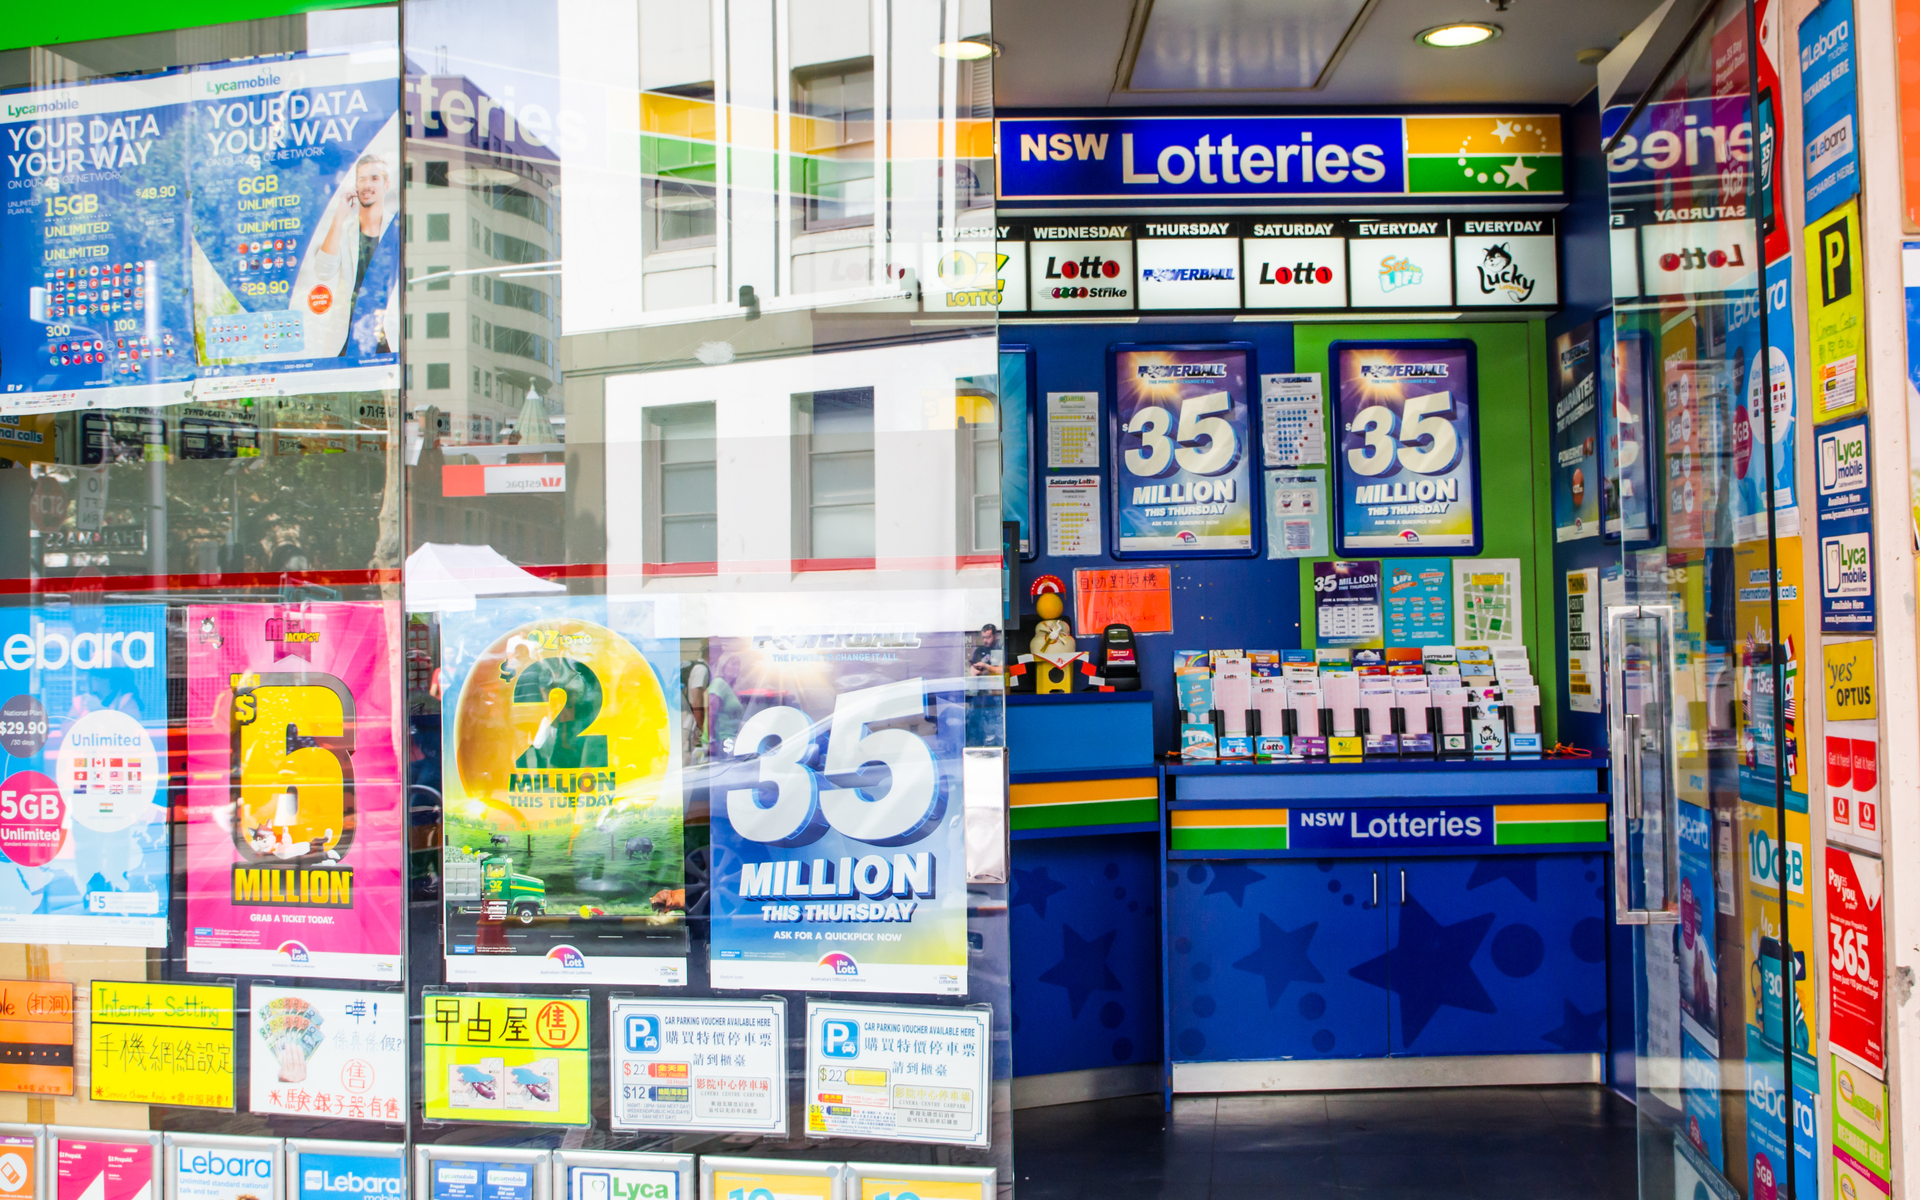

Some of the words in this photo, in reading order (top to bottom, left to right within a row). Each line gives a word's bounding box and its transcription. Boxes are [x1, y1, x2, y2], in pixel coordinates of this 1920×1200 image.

[1808, 20, 1849, 67] Lebara
[206, 71, 281, 95] Lycamobile
[1803, 71, 1831, 106] RECHARGE
[1830, 58, 1850, 82] HERE
[207, 97, 286, 129] YOUR
[290, 89, 369, 120] DATA
[8, 122, 85, 152] YOUR
[89, 114, 160, 145] DATA
[207, 124, 286, 156] YOUR
[291, 116, 360, 147] WAY
[8, 149, 85, 178] YOUR
[90, 140, 153, 170] WAY
[1020, 133, 1109, 161] NSW
[1121, 131, 1386, 185] Lotteries
[8, 181, 21, 189] ON
[237, 174, 278, 196] 6GB
[1807, 171, 1837, 203] RECHARGE
[1836, 161, 1855, 183] HERE
[136, 185, 176, 200] $49.90
[45, 194, 98, 217] 15GB
[238, 194, 300, 212] UNLIMITED
[45, 221, 109, 238] UNLIMITED
[238, 217, 300, 234] UNLIMITED
[938, 226, 1011, 239] TUESDAY
[1033, 225, 1128, 239] WEDNESDAY
[1146, 222, 1230, 236] THURSDAY
[1253, 223, 1334, 237] SATURDAY
[1359, 222, 1439, 236] EVERYDAY
[1465, 220, 1543, 234] EVERYDAY
[45, 244, 109, 261] UNLIMITED
[1045, 256, 1120, 279] Lotto
[1142, 267, 1235, 282] POWERBALL
[1259, 261, 1333, 285] Lotto
[240, 280, 290, 298] $29.90
[1476, 260, 1535, 302] Lucky
[310, 294, 329, 302] SPECIAL
[946, 291, 1003, 307] LOTTO
[1088, 287, 1127, 299] Strike
[46, 325, 70, 337] 300
[114, 319, 136, 332] 100
[1360, 362, 1449, 379] POWERBALL
[17, 430, 43, 443] calls
[1836, 439, 1862, 465] Lyca
[1837, 461, 1863, 479] mobile
[1049, 479, 1078, 487] Saturday
[1078, 478, 1096, 486] Lotto
[1354, 477, 1458, 505] MILLION
[1132, 478, 1236, 506] MILLION
[1145, 506, 1168, 517] THIS
[1168, 504, 1226, 517] THURSDAY
[1367, 506, 1390, 517] THIS
[1389, 503, 1449, 517] THURSDAY
[1840, 543, 1867, 570] Lyca
[1314, 574, 1338, 593] 35
[1338, 574, 1378, 587] MILLION
[1841, 567, 1867, 584] mobile
[1782, 584, 1797, 599] calls
[1569, 596, 1585, 611] ABOUT
[1569, 615, 1582, 630] YOUR
[284, 631, 320, 643] JACKPOT
[526, 629, 560, 651] OZ
[560, 634, 594, 646] LOTTO
[1569, 633, 1591, 649] CHOICES
[772, 653, 790, 663] THE
[790, 653, 822, 662] POWER
[822, 654, 834, 662] TO
[835, 653, 870, 662] CHANGE
[871, 653, 880, 662] IT
[881, 653, 899, 662] ALL
[230, 673, 261, 687] OVER
[1836, 685, 1871, 707] OPTUS
[4, 709, 29, 717] National
[29, 709, 43, 717] Plan
[0, 721, 47, 738] $29.90
[71, 733, 142, 747] Unlimited
[1261, 743, 1284, 752] Lotto
[1828, 752, 1837, 766] Get
[1837, 753, 1841, 766] it
[1854, 755, 1863, 769] Get
[1863, 757, 1866, 770] it
[508, 770, 616, 794] MILLION
[1, 790, 60, 820] 5GB
[508, 795, 544, 809] THIS
[548, 793, 617, 809] TUESDAY
[1299, 811, 1344, 828] NSW
[1350, 810, 1482, 839] Lotteries
[1, 828, 60, 841] Unlimited
[739, 852, 936, 901] MILLION
[1828, 868, 1843, 893] Pay
[1842, 885, 1856, 903] you
[250, 914, 273, 923] GRAB
[274, 915, 281, 923] A
[281, 914, 307, 924] TICKET
[307, 915, 335, 925] TODAY.
[761, 903, 805, 923] THIS
[804, 902, 918, 923] THURSDAY
[773, 931, 793, 940] ASK
[794, 931, 813, 941] FOR
[815, 932, 823, 941] A
[824, 931, 875, 942] QUICKPICK
[876, 932, 902, 942] NOW
[563, 953, 575, 961] the
[1829, 922, 1871, 982] 365
[563, 958, 584, 968] Lott
[836, 965, 856, 975] Lott
[1832, 970, 1841, 983] from
[1841, 974, 1850, 987] just
[1862, 983, 1879, 1000] recharge
[1868, 974, 1879, 989] days
[98, 988, 154, 1018] Internet
[165, 995, 219, 1027] Setting
[664, 1016, 676, 1025] CAR
[676, 1016, 700, 1026] PARKING
[701, 1017, 727, 1026] VOUCHER
[726, 1017, 756, 1026] AVAILABLE
[757, 1018, 771, 1027] HERE
[864, 1022, 876, 1031] CAR
[876, 1022, 901, 1033] PARKING
[901, 1023, 928, 1034] VOUCHER
[929, 1025, 960, 1036] AVAILABLE
[960, 1027, 976, 1037] HERE
[665, 1030, 772, 1047] 購買特價停車票
[864, 1037, 976, 1057] 購買特價停車票
[95, 1033, 233, 1075] 手機網絡設定
[623, 1086, 645, 1100] $12
[696, 1078, 769, 1092] 影院中心停車場
[179, 1149, 272, 1178] Lebara
[440, 1172, 475, 1182] Lycamobile
[489, 1174, 524, 1184] Lycamobile
[1755, 1159, 1772, 1188] 5GB
[179, 1178, 211, 1186] Unlimited
[212, 1180, 240, 1188] standard
[241, 1182, 269, 1190] national
[324, 1170, 401, 1195] Lebara
[613, 1177, 669, 1200] Lyca
